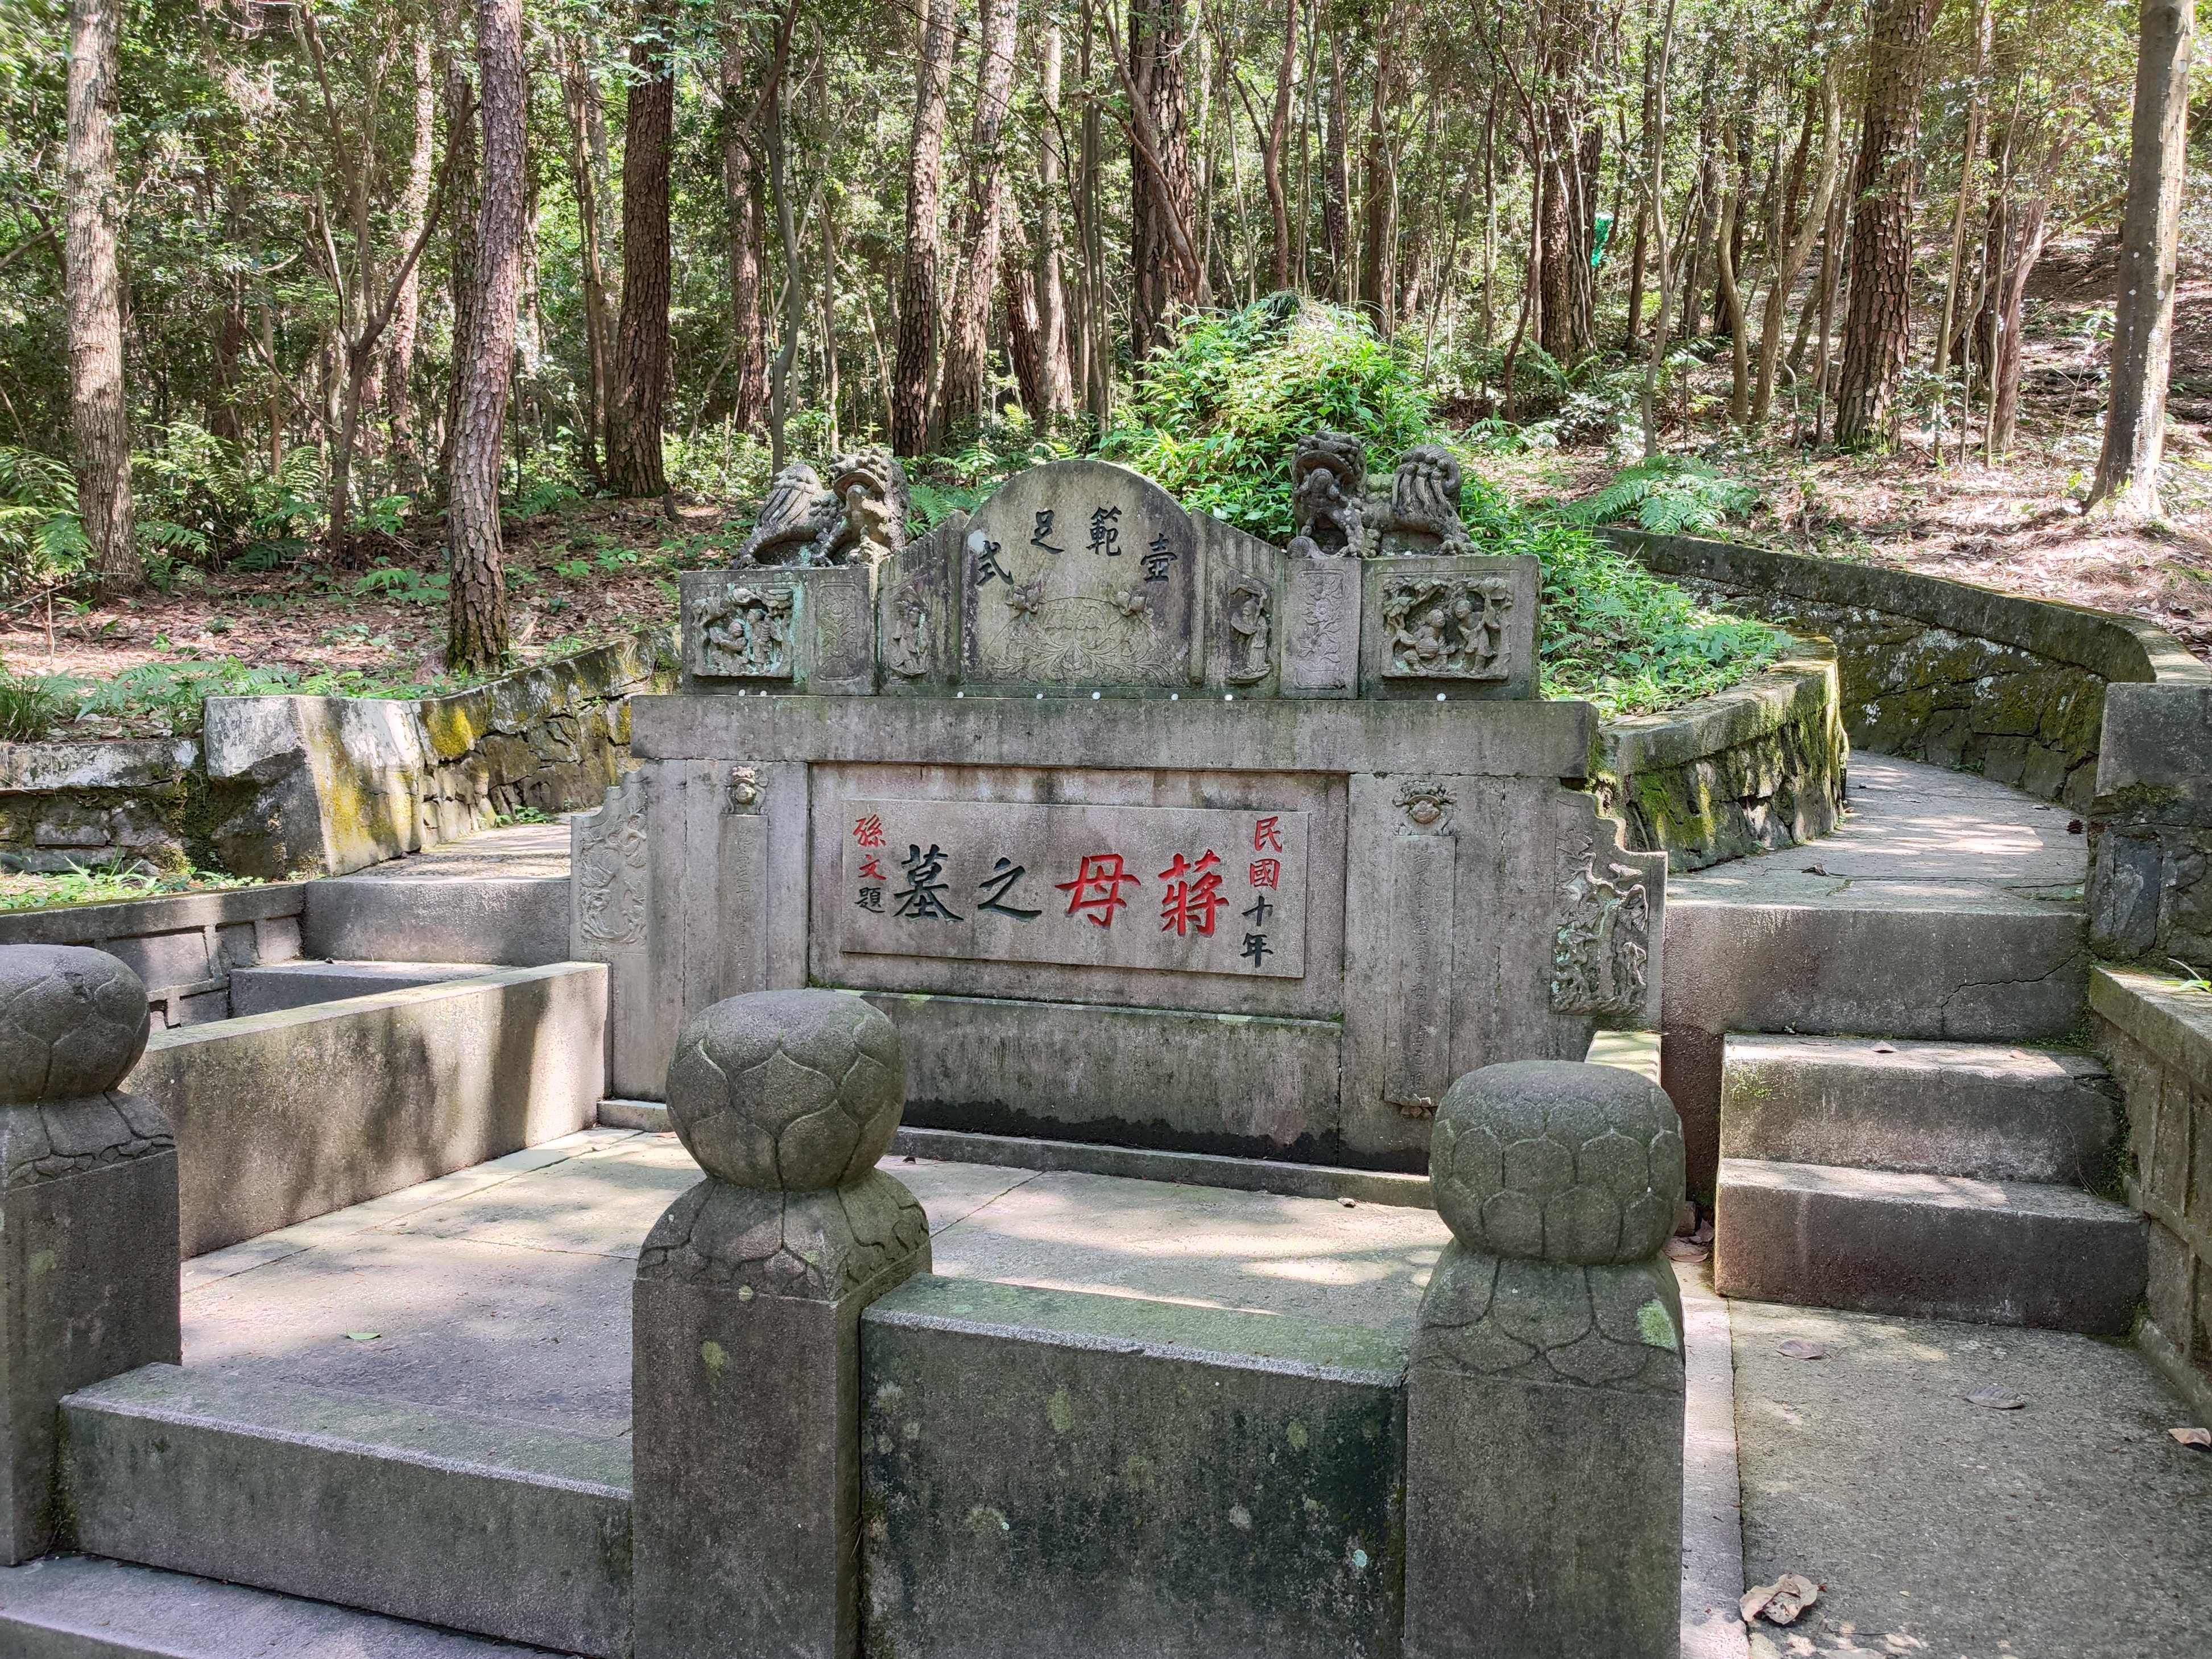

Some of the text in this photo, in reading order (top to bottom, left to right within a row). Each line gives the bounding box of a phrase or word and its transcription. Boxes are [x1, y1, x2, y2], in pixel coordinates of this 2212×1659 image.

[853, 814, 887, 913] 孫文題
[892, 843, 1230, 938] 蔣母之墓
[1240, 816, 1283, 968] 民國十年
